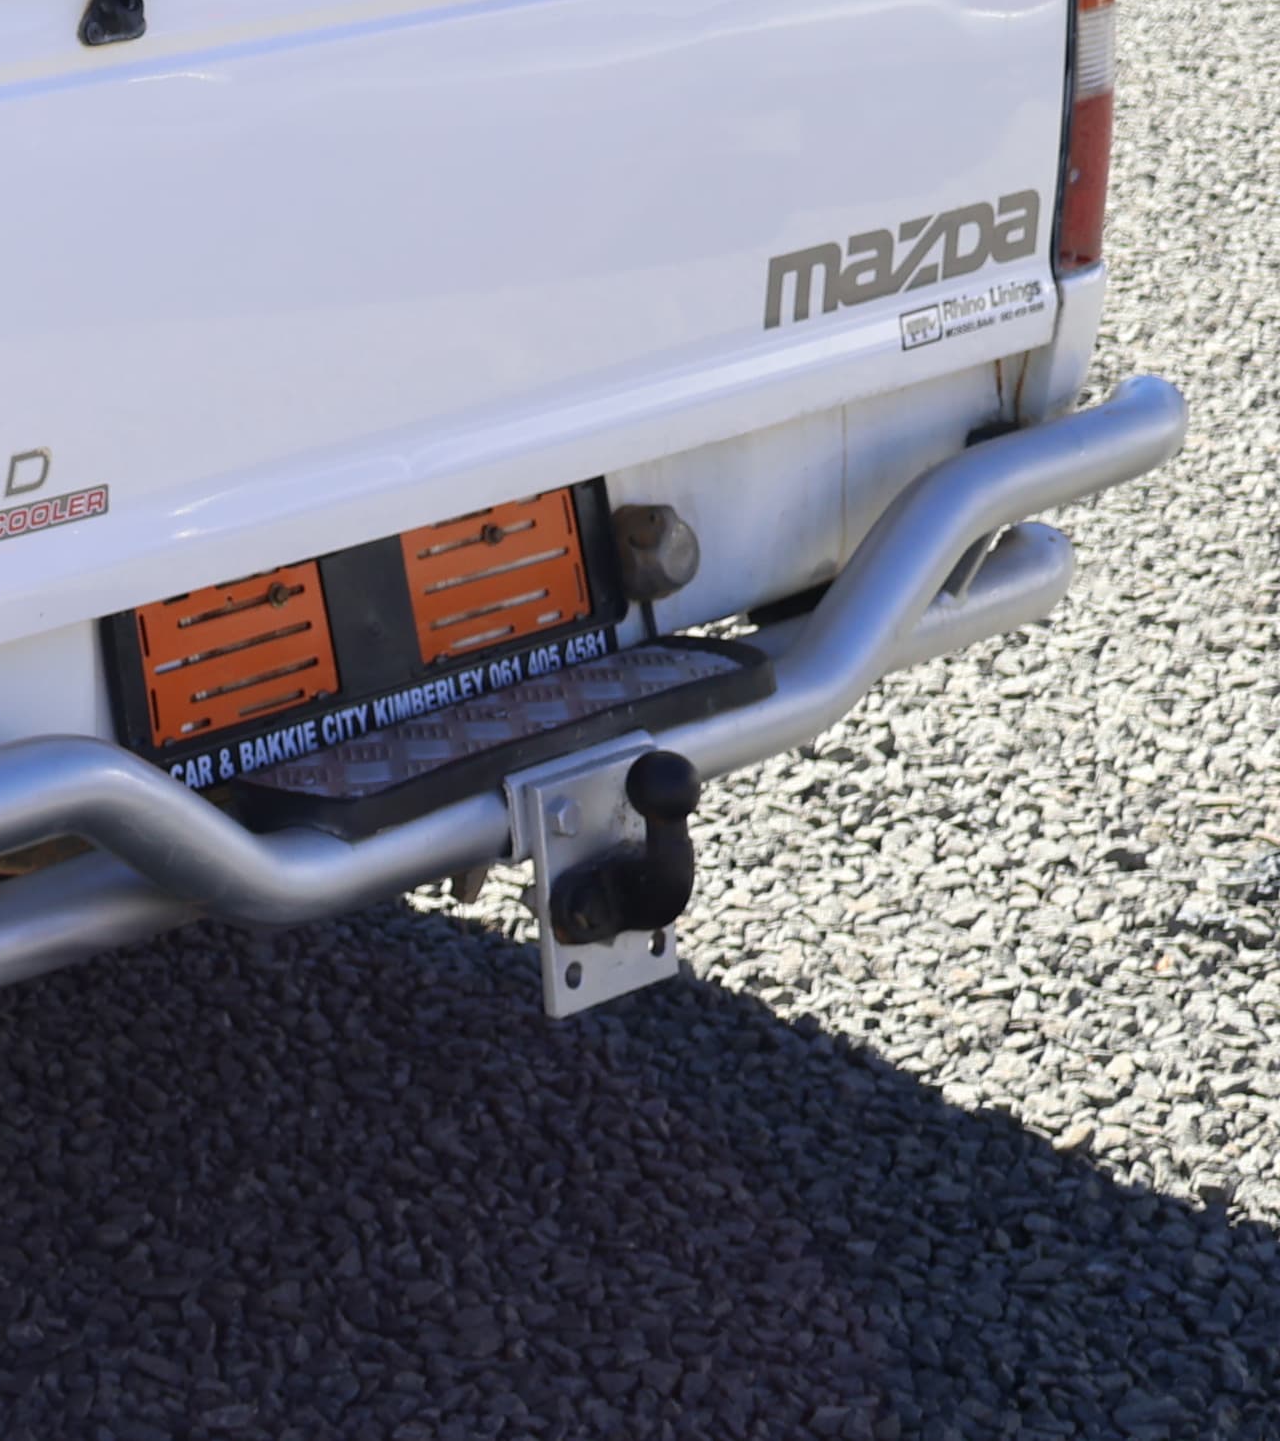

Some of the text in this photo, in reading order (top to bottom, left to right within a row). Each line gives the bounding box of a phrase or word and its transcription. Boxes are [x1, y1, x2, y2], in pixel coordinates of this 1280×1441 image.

[942, 293, 987, 321] Rhino
[989, 280, 1042, 307] Linings
[218, 748, 237, 779] &
[239, 719, 319, 772] BAKKIE
[321, 706, 371, 743] CITY
[373, 667, 486, 730] KIMBERLEY
[488, 657, 523, 689] 061
[526, 644, 562, 676] 405
[564, 629, 608, 666] 4581
